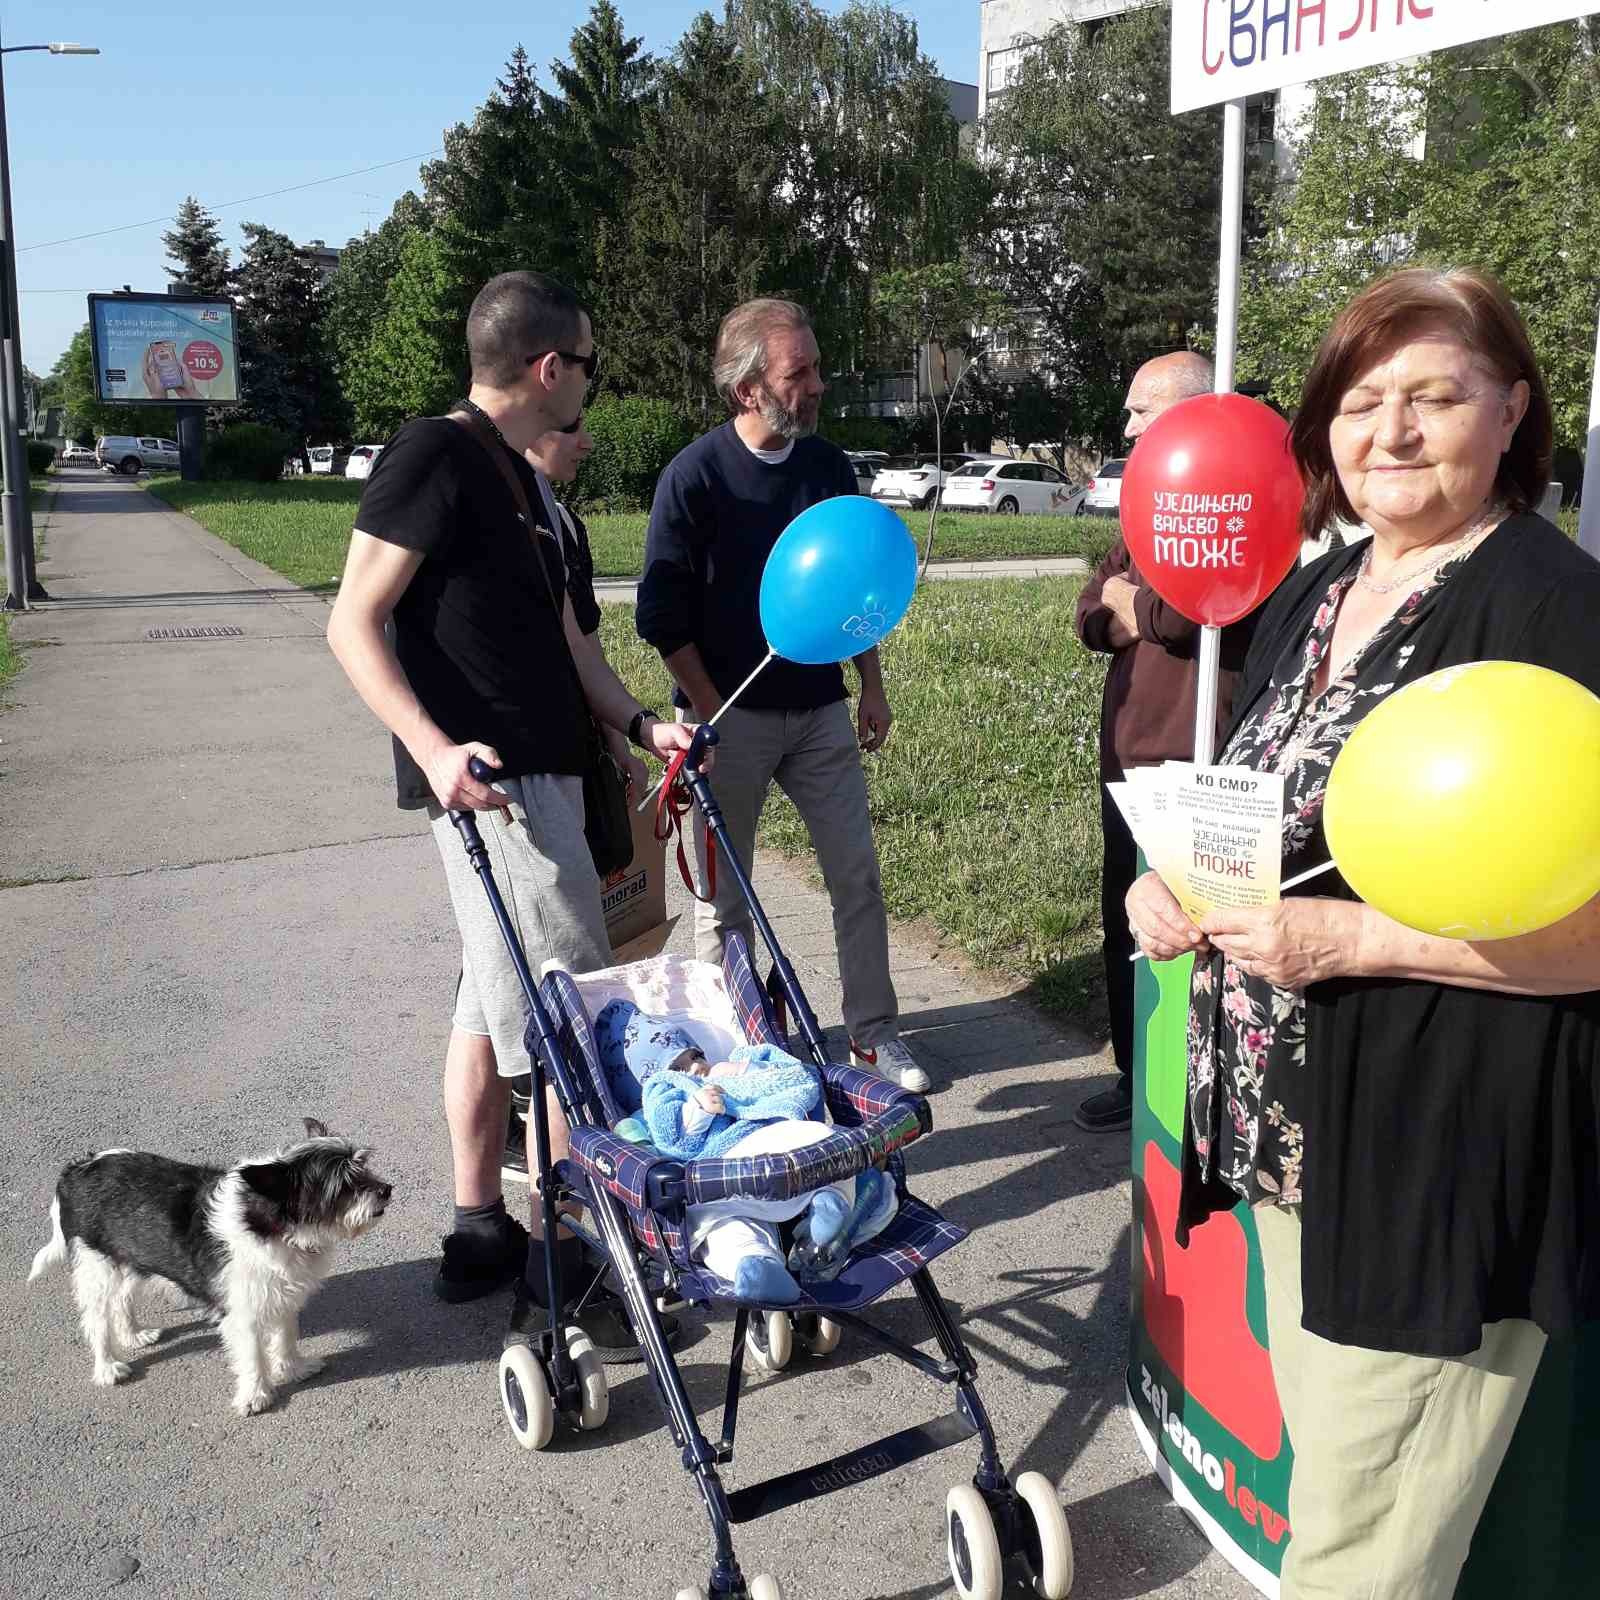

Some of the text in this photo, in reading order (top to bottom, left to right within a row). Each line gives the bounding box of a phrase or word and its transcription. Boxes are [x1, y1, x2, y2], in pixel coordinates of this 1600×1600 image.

[1153, 492, 1253, 514] УЈЕДИЊЕНО
[1153, 514, 1219, 535] ВАЉЕВО
[1153, 535, 1248, 568] МОЖЕ
[1196, 773, 1258, 793] КО СМО?
[1193, 829, 1257, 848] УЈЕДИЊЕНО
[1193, 840, 1237, 857] ВАЉЕВО
[1193, 851, 1257, 880] МОЖЕ
[1141, 1363, 1293, 1544] zelenolev
